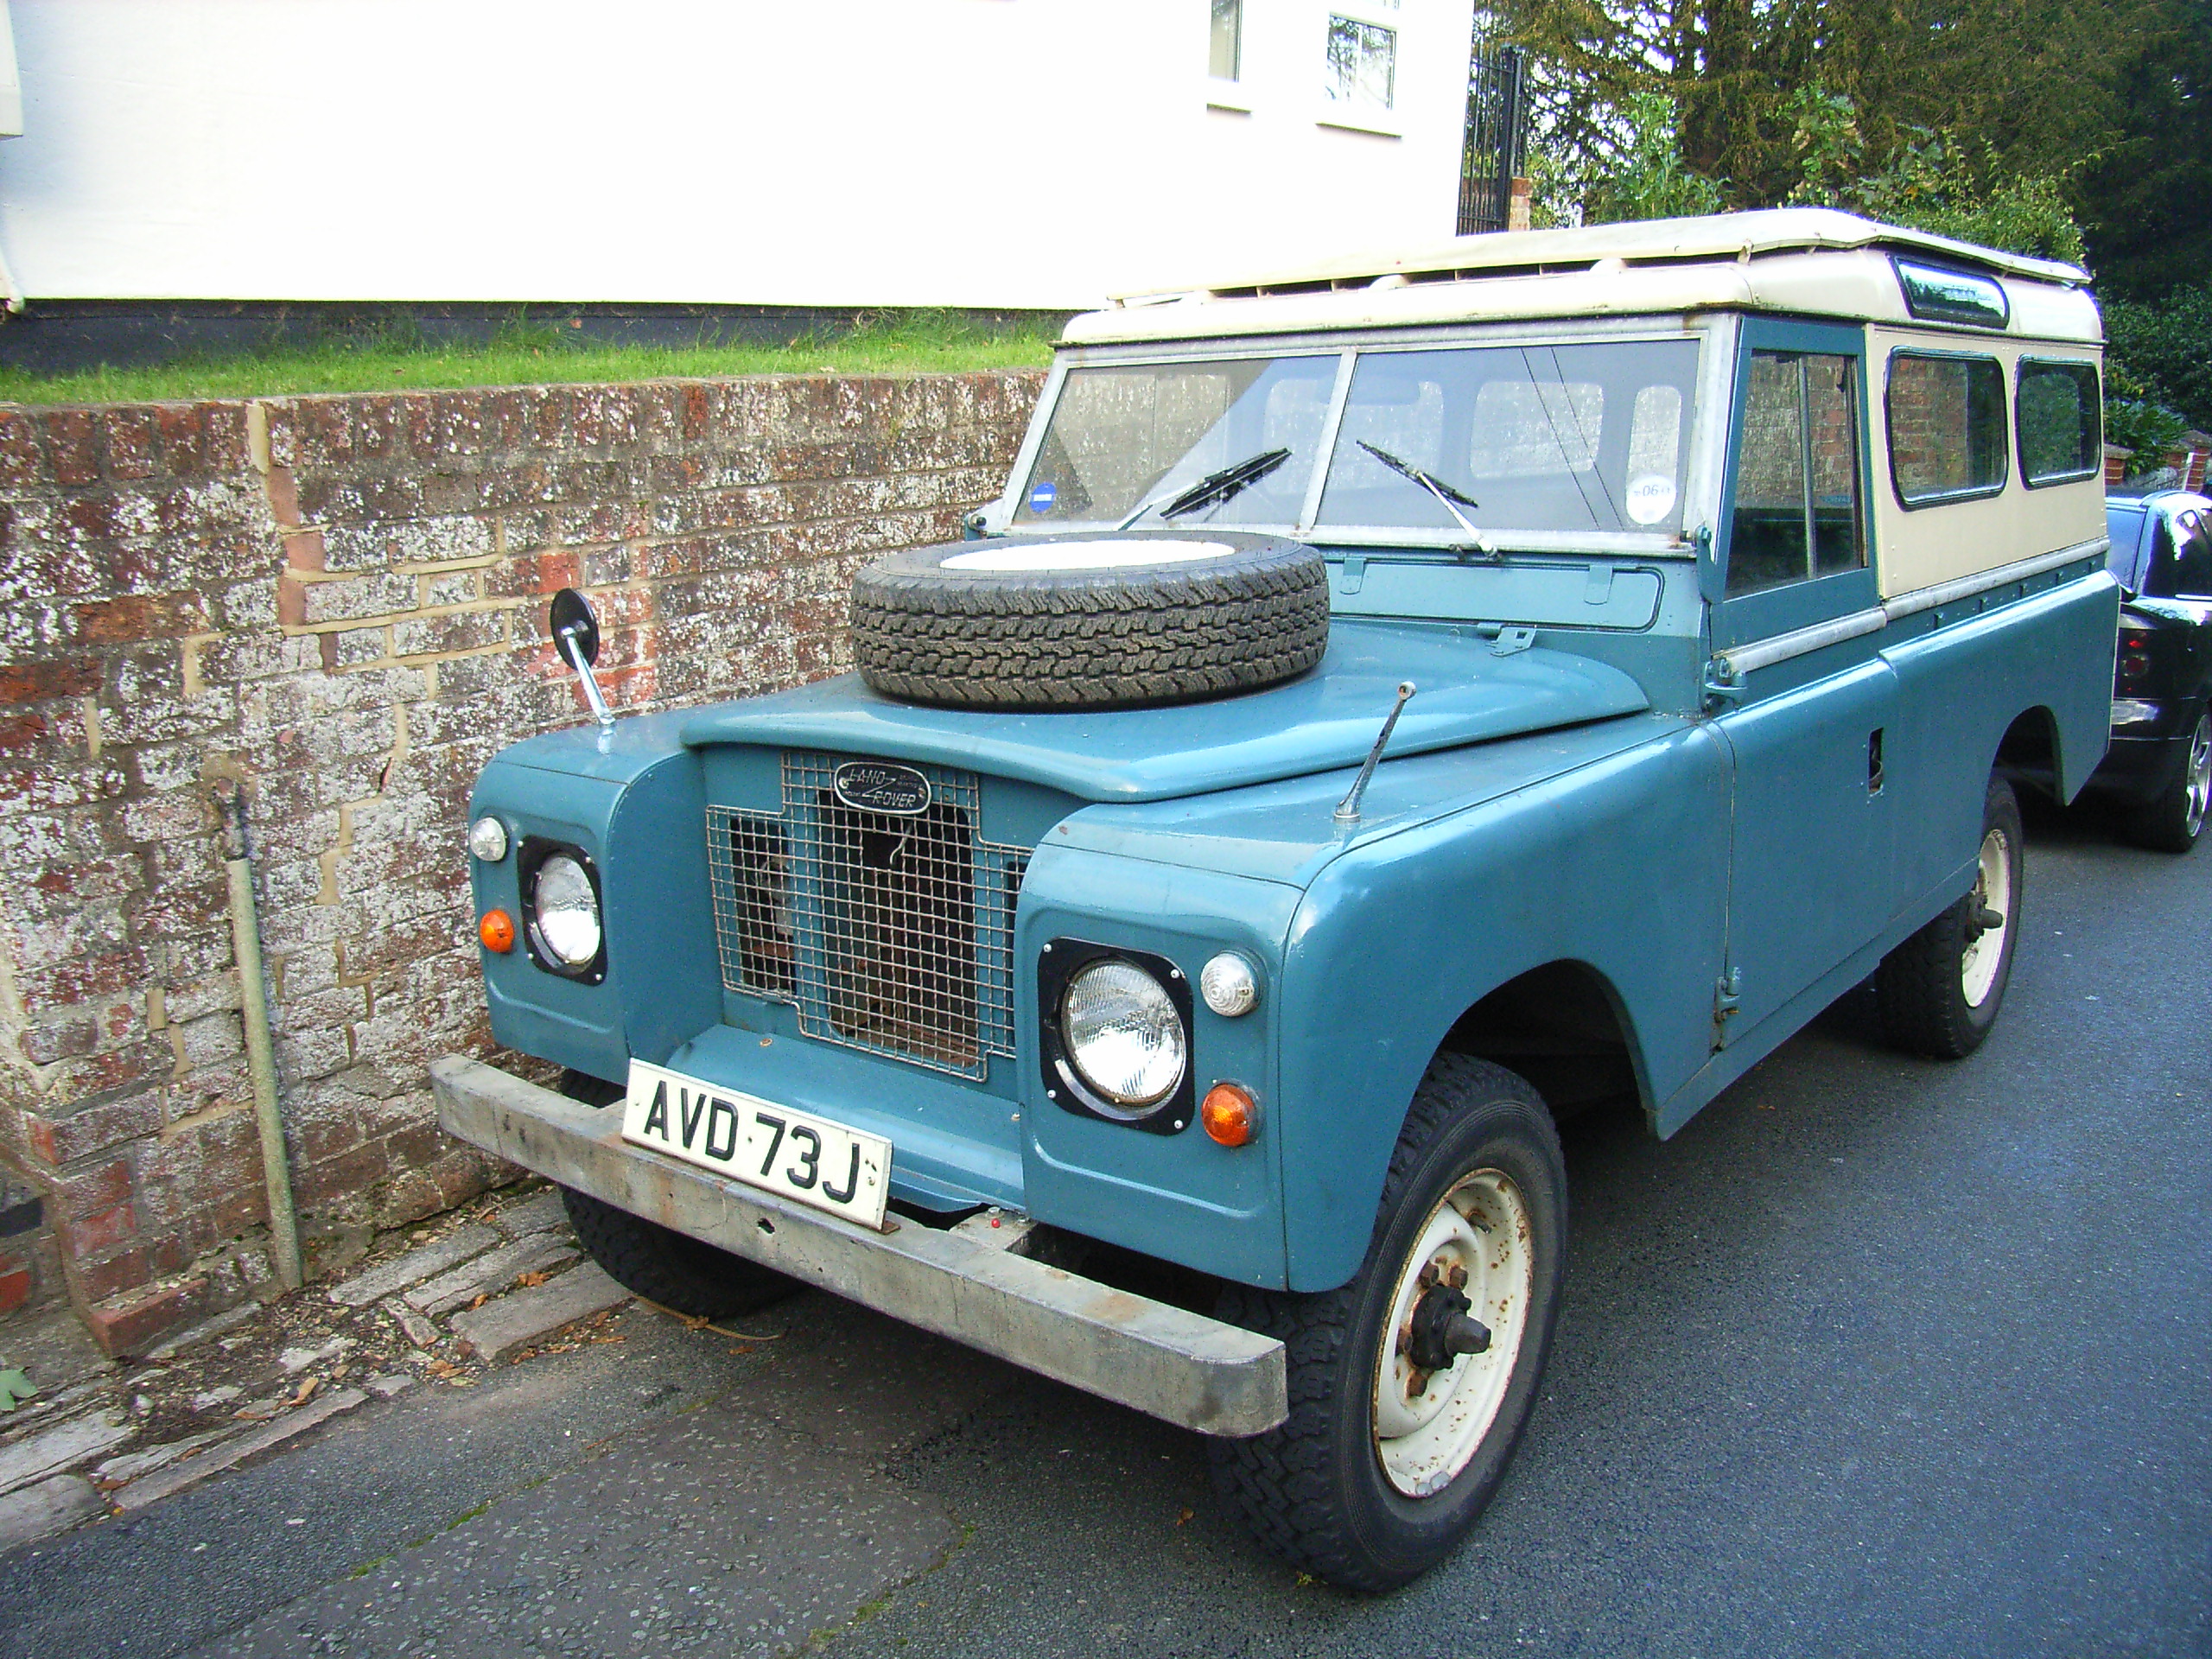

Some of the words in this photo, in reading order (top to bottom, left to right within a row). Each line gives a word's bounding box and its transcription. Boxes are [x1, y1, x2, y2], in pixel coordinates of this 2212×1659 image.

[849, 768, 887, 785] LAND
[872, 791, 916, 808] ROVER
[644, 1079, 739, 1161] AVD
[755, 1111, 861, 1205] 73J
